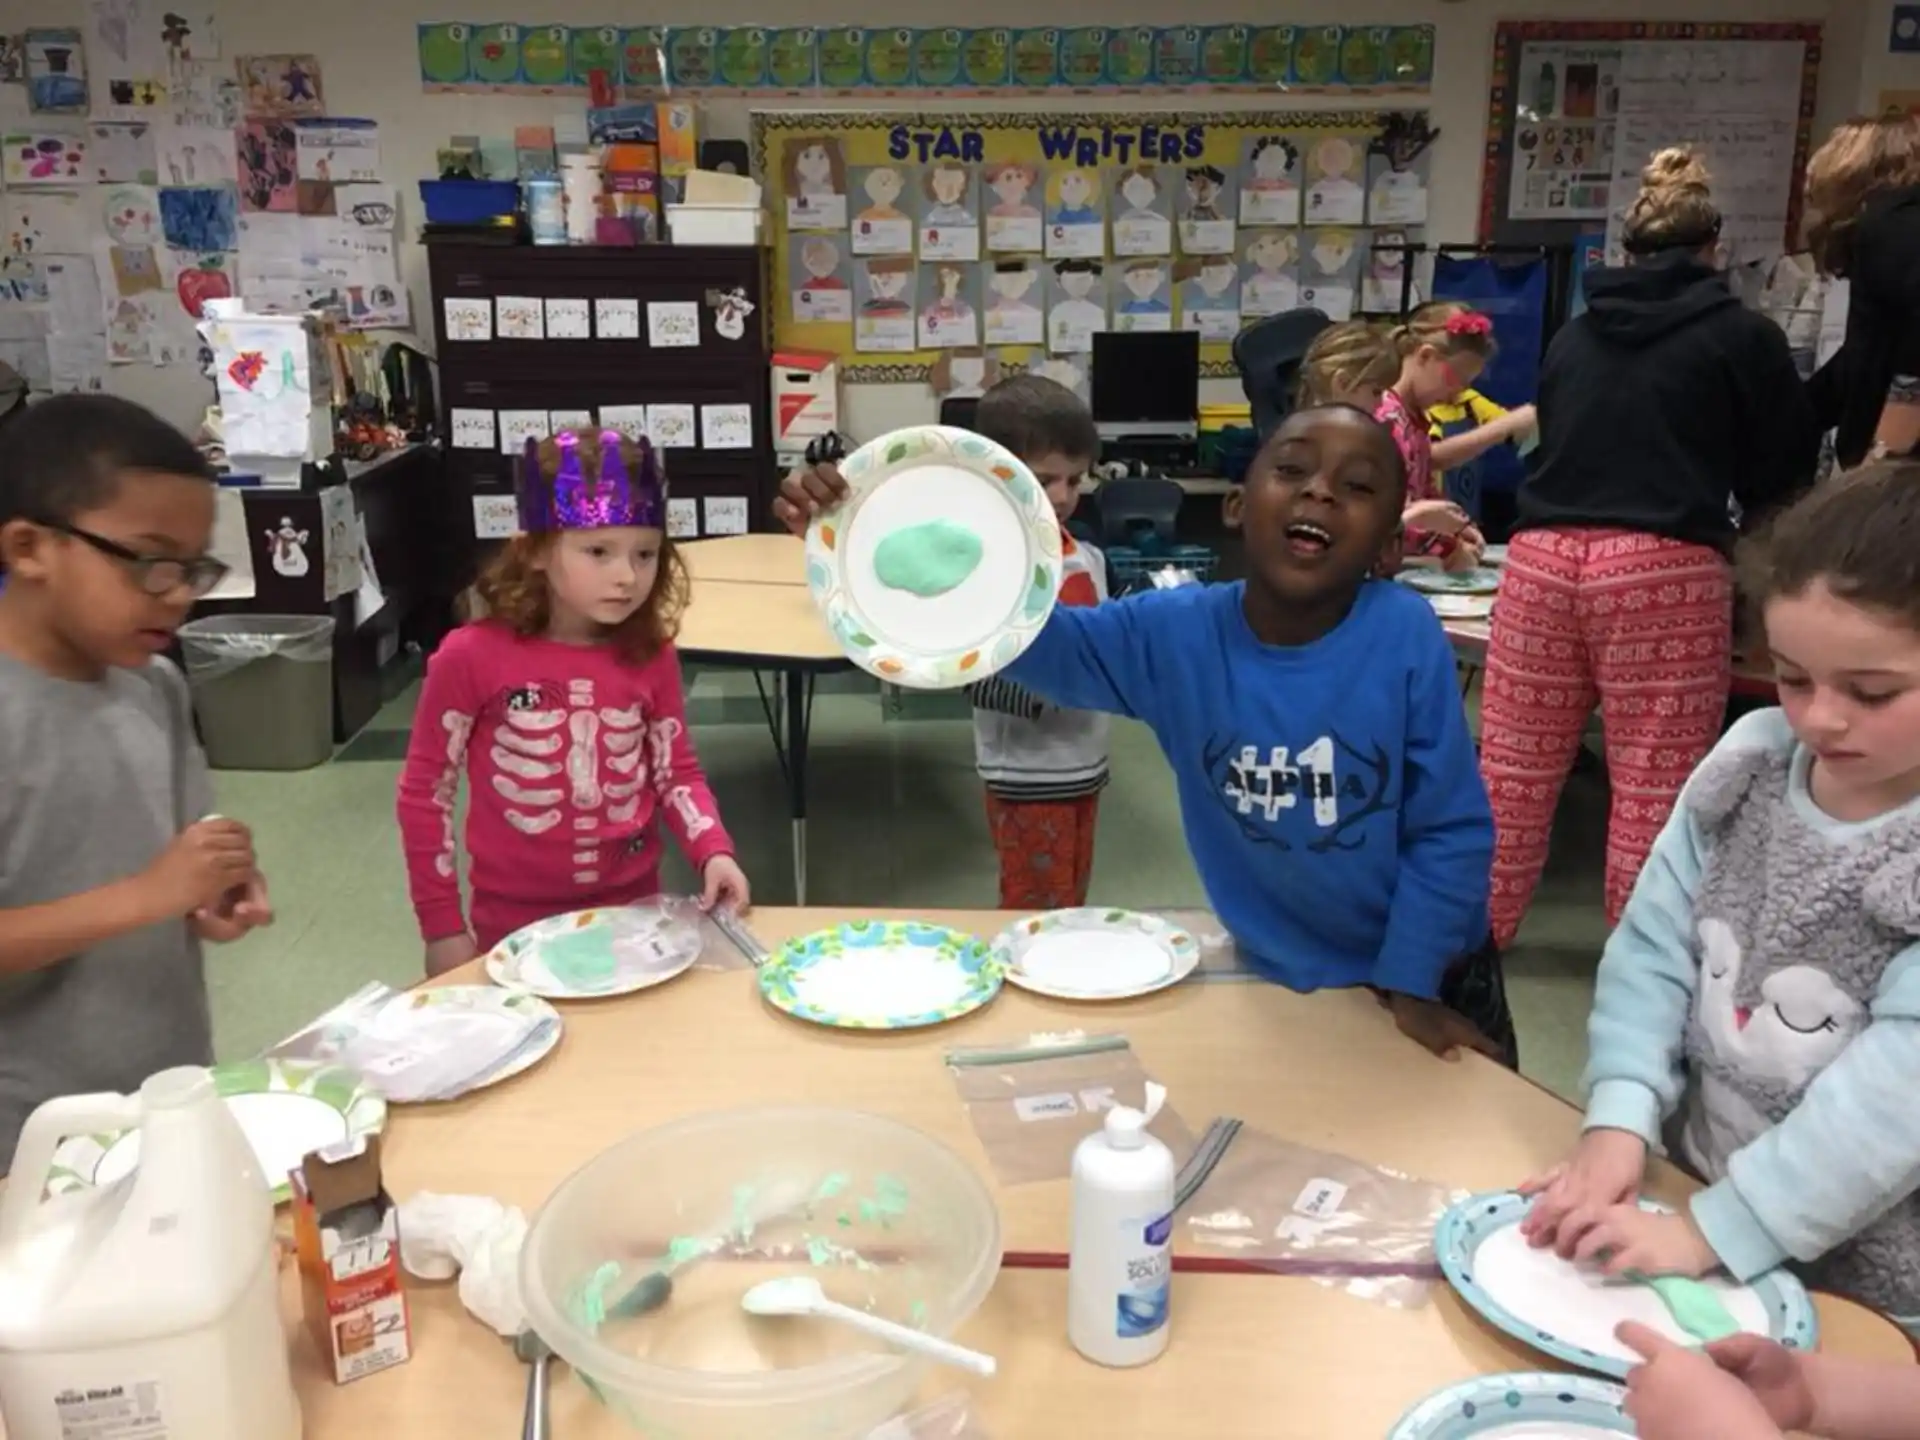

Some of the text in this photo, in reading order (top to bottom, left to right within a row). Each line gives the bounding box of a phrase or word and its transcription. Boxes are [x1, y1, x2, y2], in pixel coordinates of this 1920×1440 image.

[888, 122, 1205, 166] STAR WRITERS
[1588, 532, 1660, 562] PINK
[1225, 735, 1338, 827] #1
